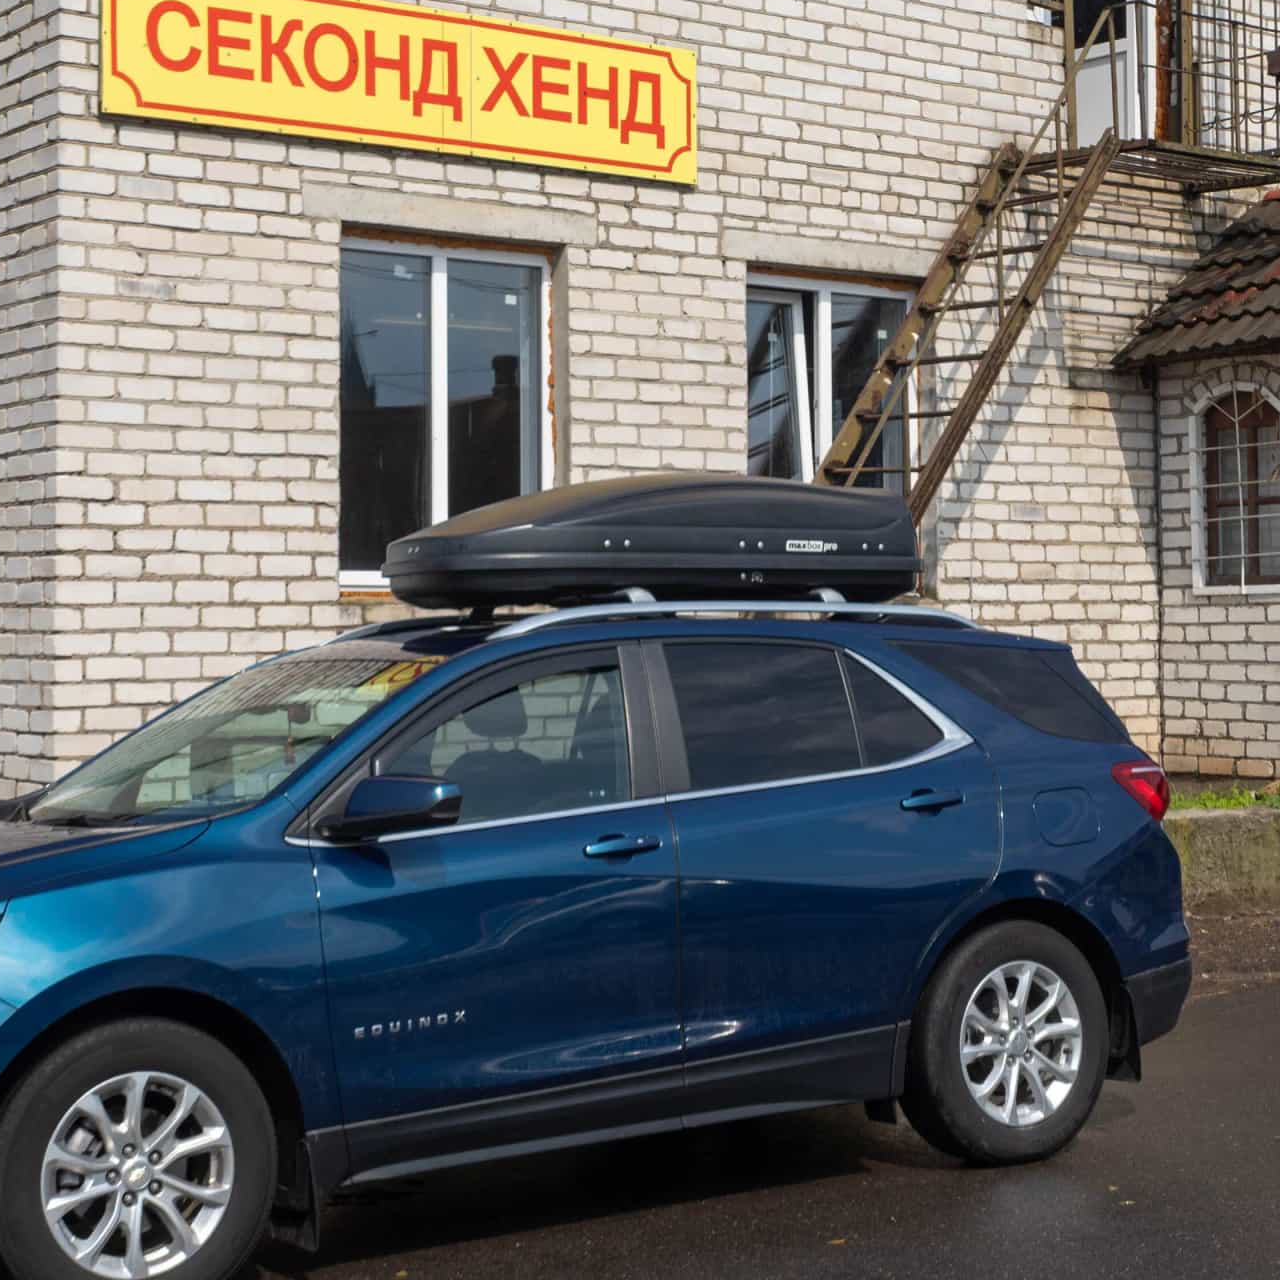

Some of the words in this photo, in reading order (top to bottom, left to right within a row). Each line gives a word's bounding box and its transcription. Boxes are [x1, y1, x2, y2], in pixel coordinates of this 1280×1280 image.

[146, 0, 463, 123] СЕКОНД
[481, 46, 666, 150] ХЕНД
[354, 1010, 465, 1039] EQUINOX
